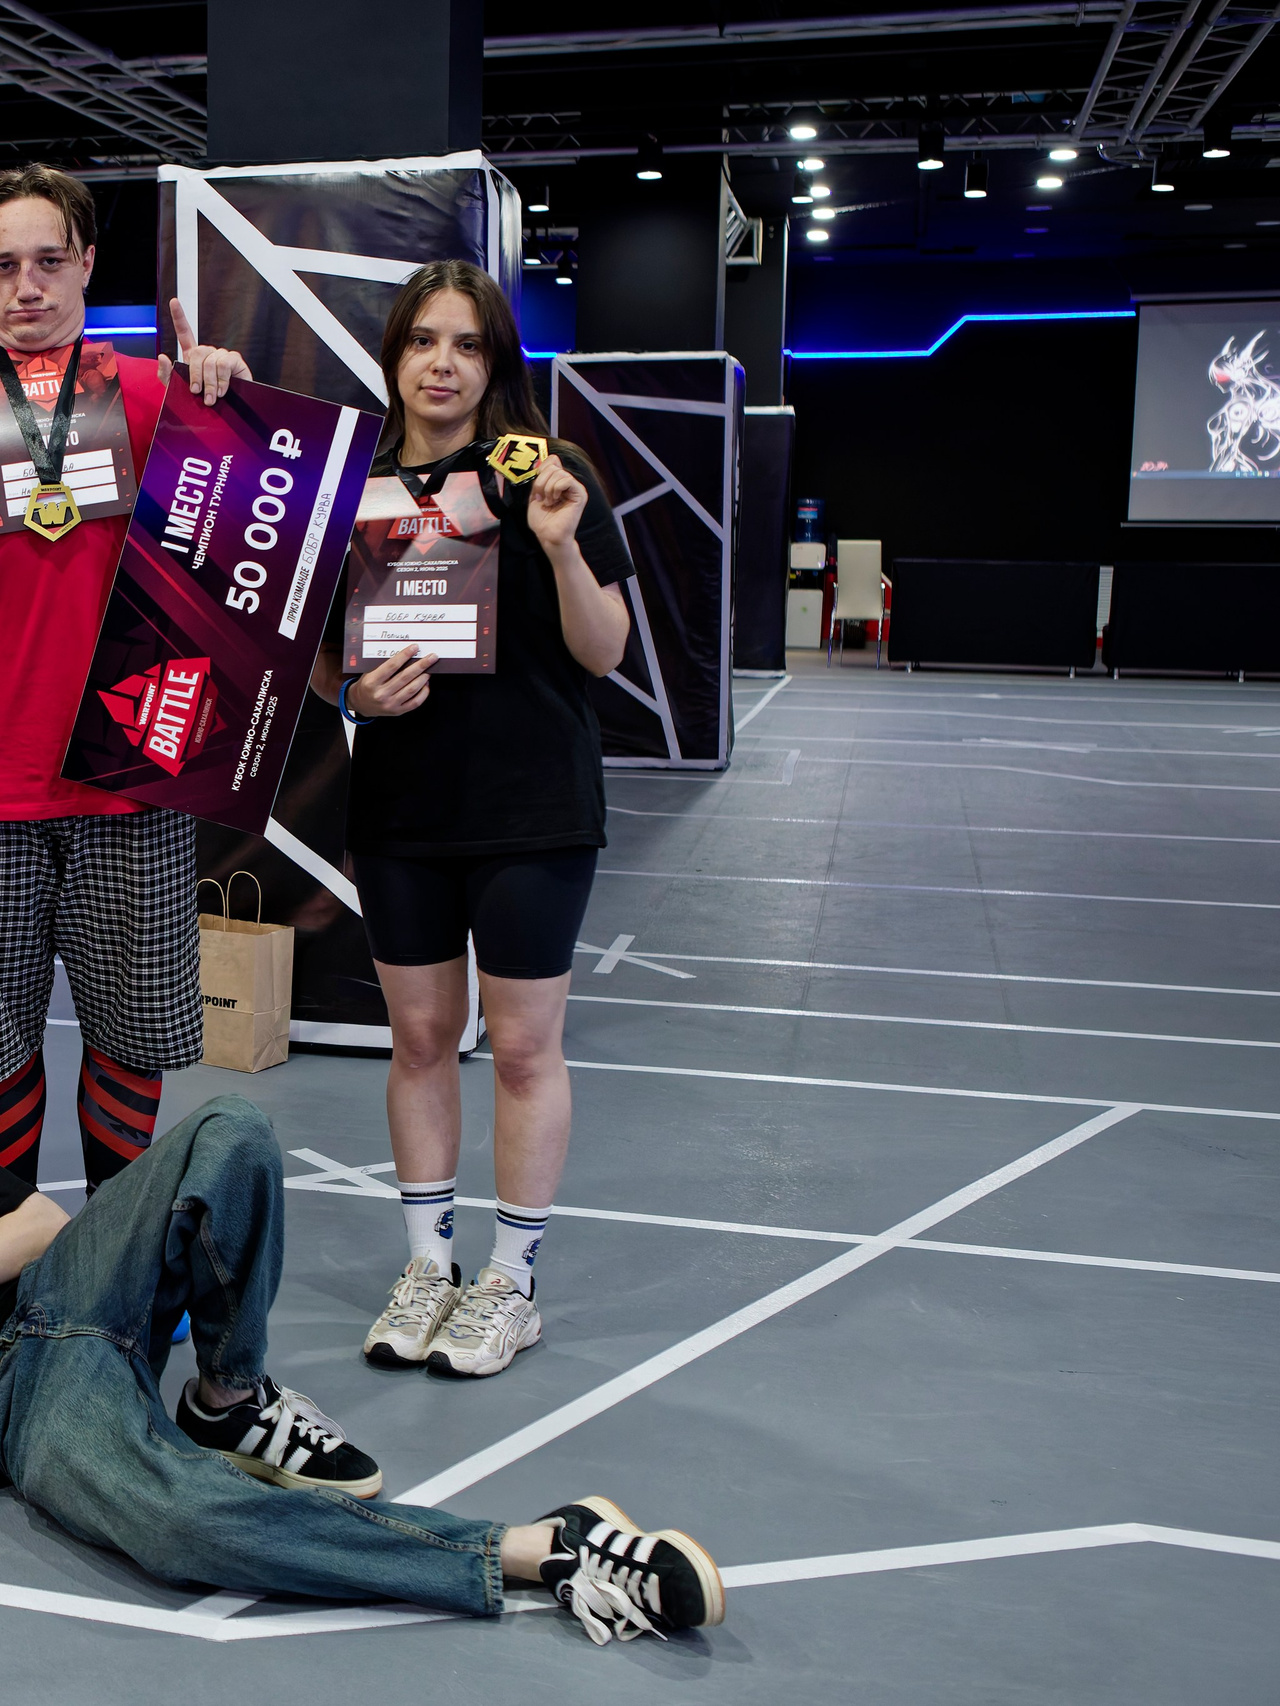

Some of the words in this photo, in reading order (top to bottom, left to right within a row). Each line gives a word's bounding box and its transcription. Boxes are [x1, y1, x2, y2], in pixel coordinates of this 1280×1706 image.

[21, 378, 64, 397] BATTL
[164, 457, 213, 541] МЕСТО
[192, 510, 218, 569] ЧЕМПИОН
[212, 454, 234, 512] ТУРНИРА
[243, 468, 294, 551] 000
[313, 493, 332, 529] КУРВА
[397, 516, 453, 535] BATTLE
[302, 532, 320, 565] БОБР
[225, 561, 268, 615] 50
[292, 566, 310, 603] КОМАНДЕ
[403, 579, 448, 597] МЕСТО
[286, 602, 300, 623] ПРИЗ
[385, 612, 410, 621] БОБР
[414, 613, 446, 622] КУРВА
[139, 683, 157, 726] WARPOINT
[149, 669, 200, 760] BATTLE
[265, 695, 278, 718] 2025
[231, 761, 247, 792] КУБОК
